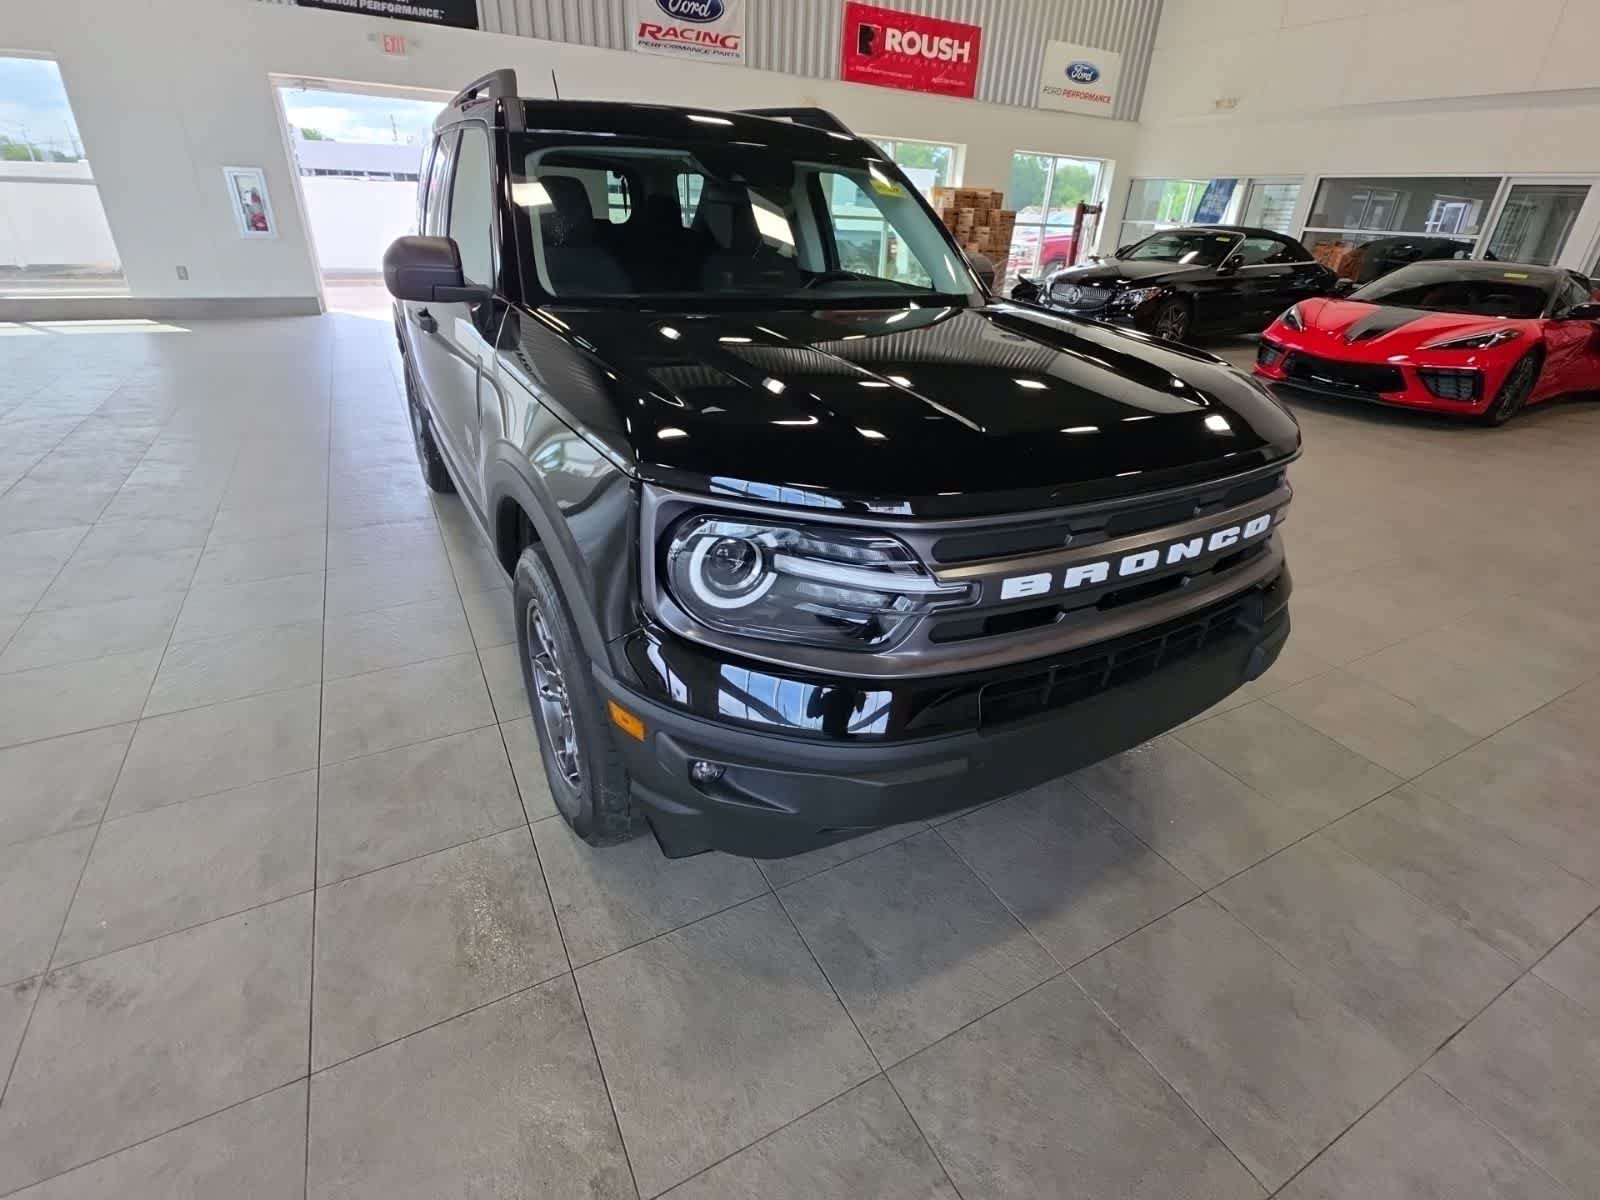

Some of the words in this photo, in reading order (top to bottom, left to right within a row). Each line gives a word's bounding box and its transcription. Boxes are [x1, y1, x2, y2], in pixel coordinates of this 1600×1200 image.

[638, 22, 742, 50] RACING
[884, 27, 971, 63] ROUSH
[638, 40, 711, 55] PERFORMANCE
[712, 48, 742, 59] PARTS
[1071, 64, 1094, 81] Ford
[1042, 86, 1061, 96] FORD
[1062, 88, 1112, 104] PERFORMANCE
[1000, 514, 1271, 600] BRONCO
